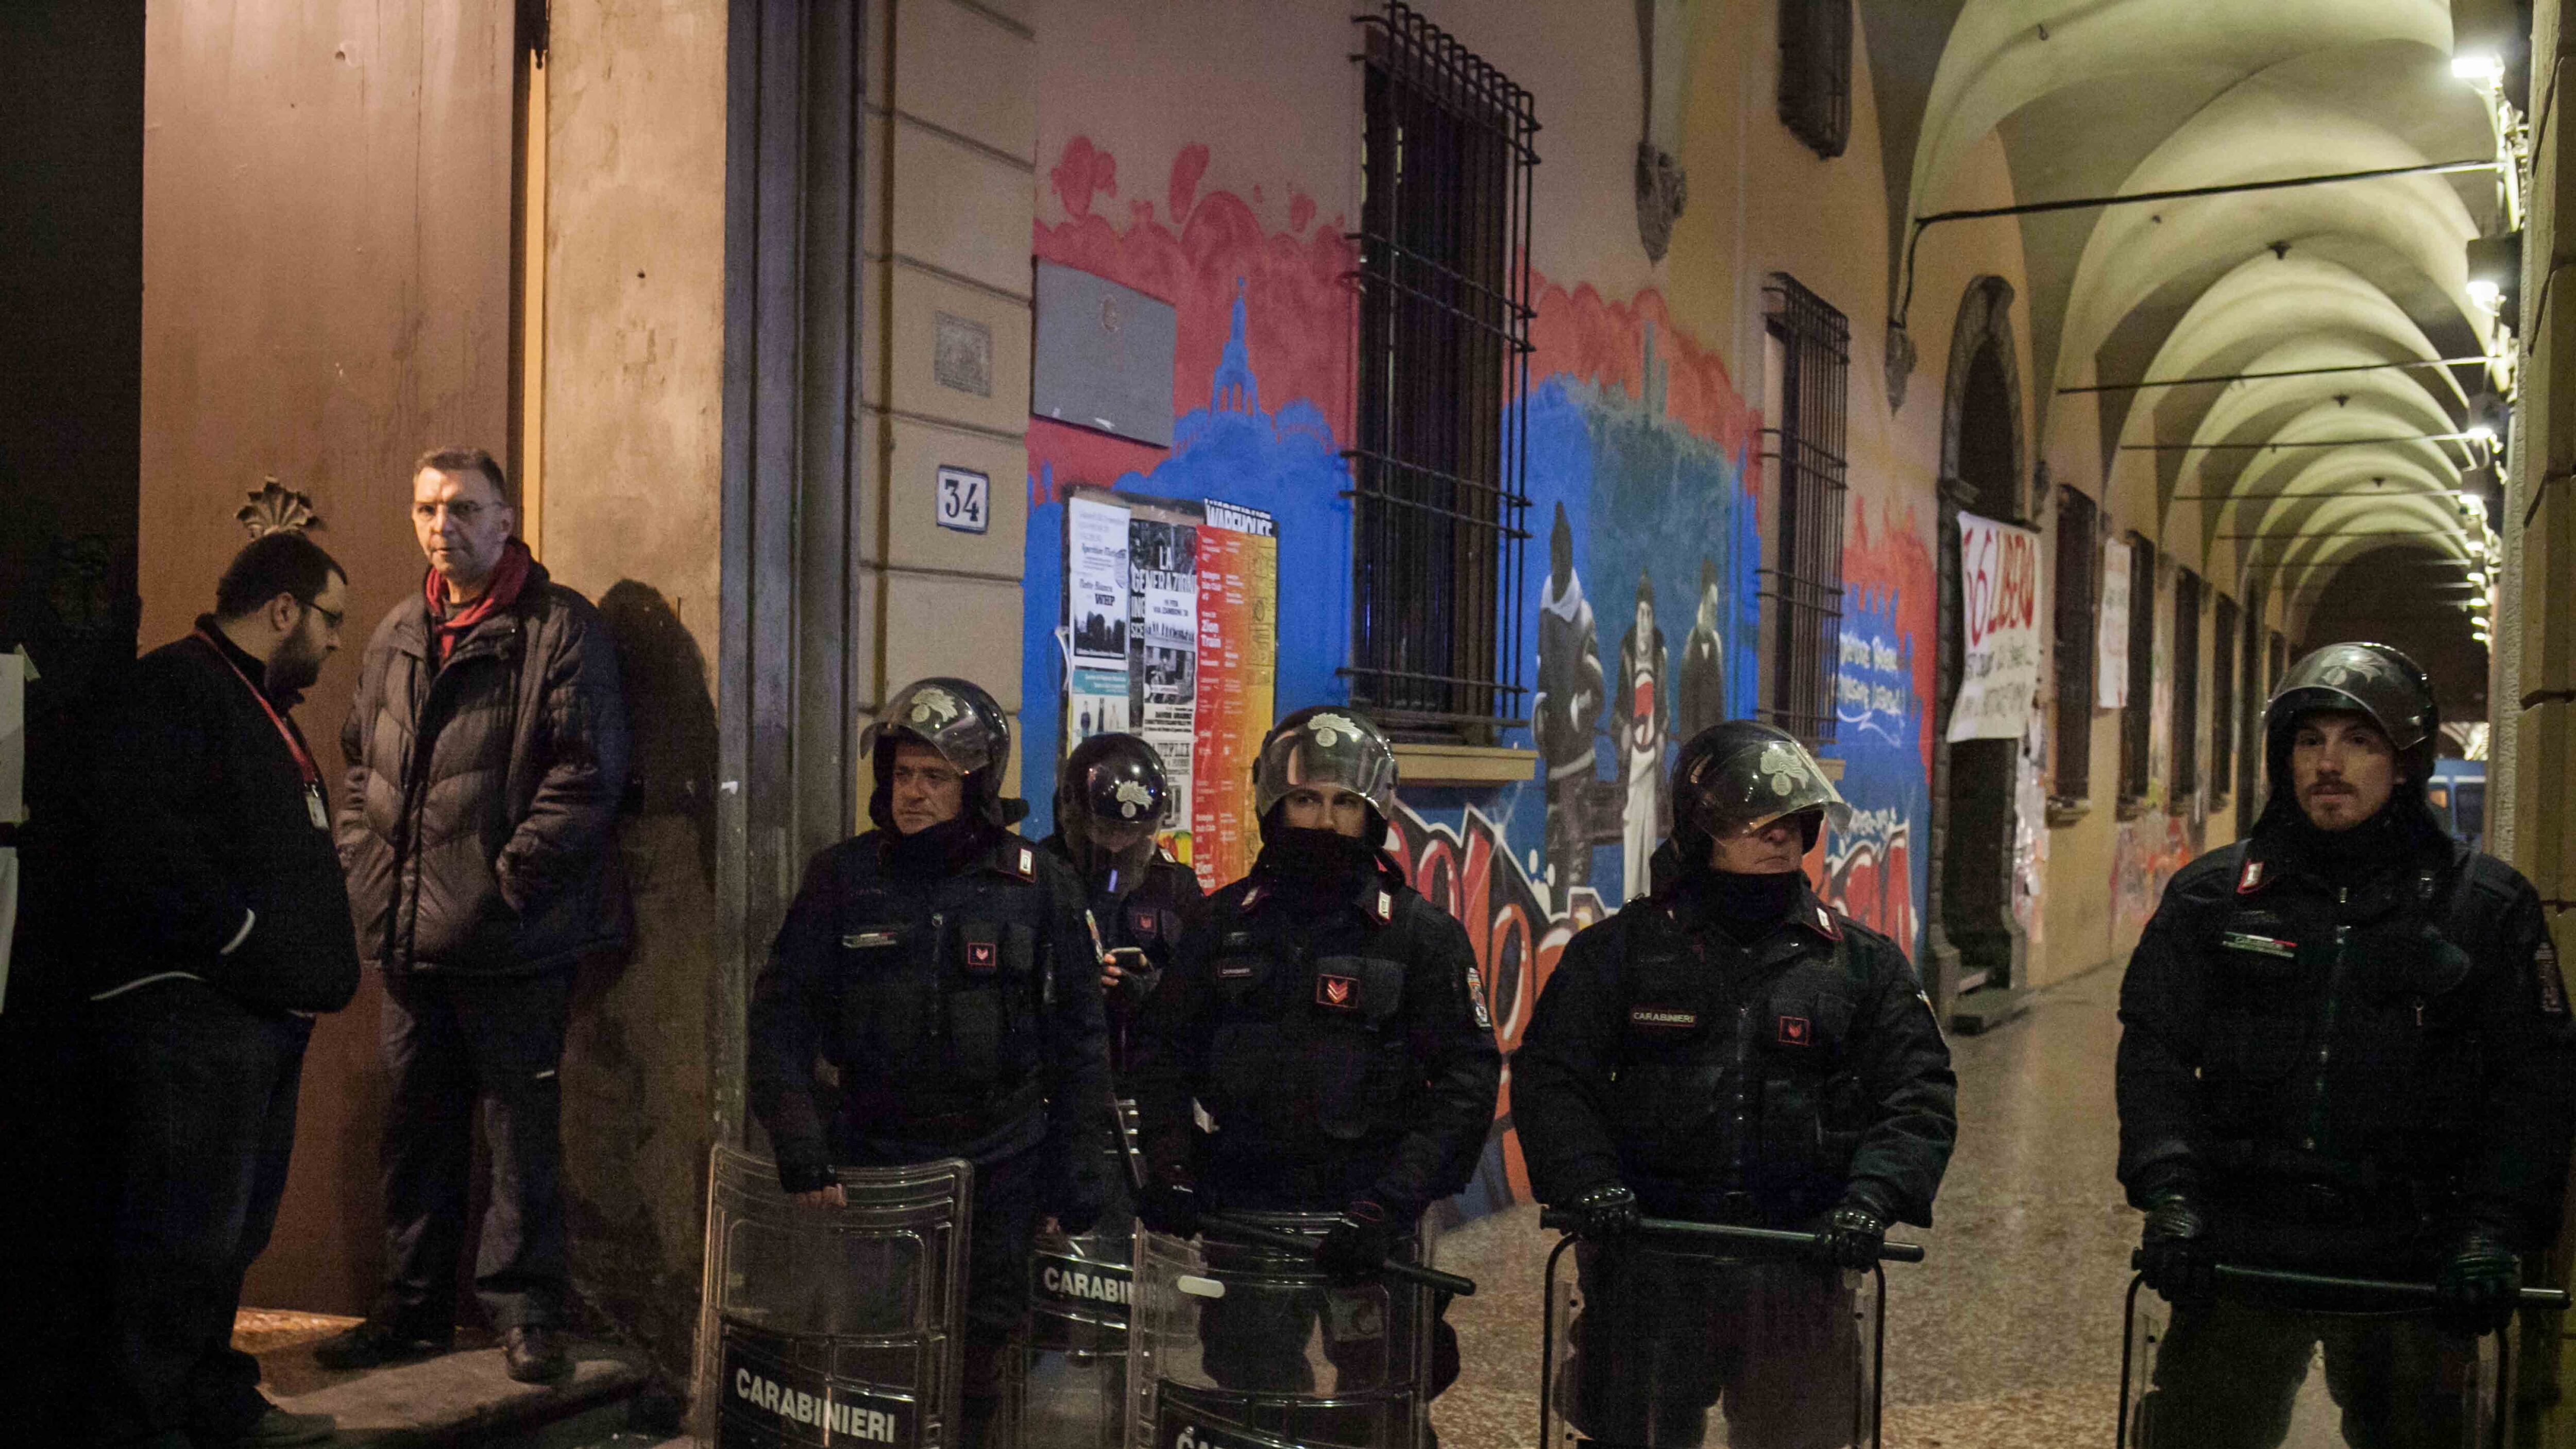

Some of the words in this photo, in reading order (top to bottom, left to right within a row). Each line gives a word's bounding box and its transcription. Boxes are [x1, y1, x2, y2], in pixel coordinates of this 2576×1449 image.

[945, 479, 979, 522] 34
[1160, 545, 1173, 570] LA
[1633, 1012, 1695, 1024] CARABINIERI
[735, 1367, 895, 1444] CARABINIERI
